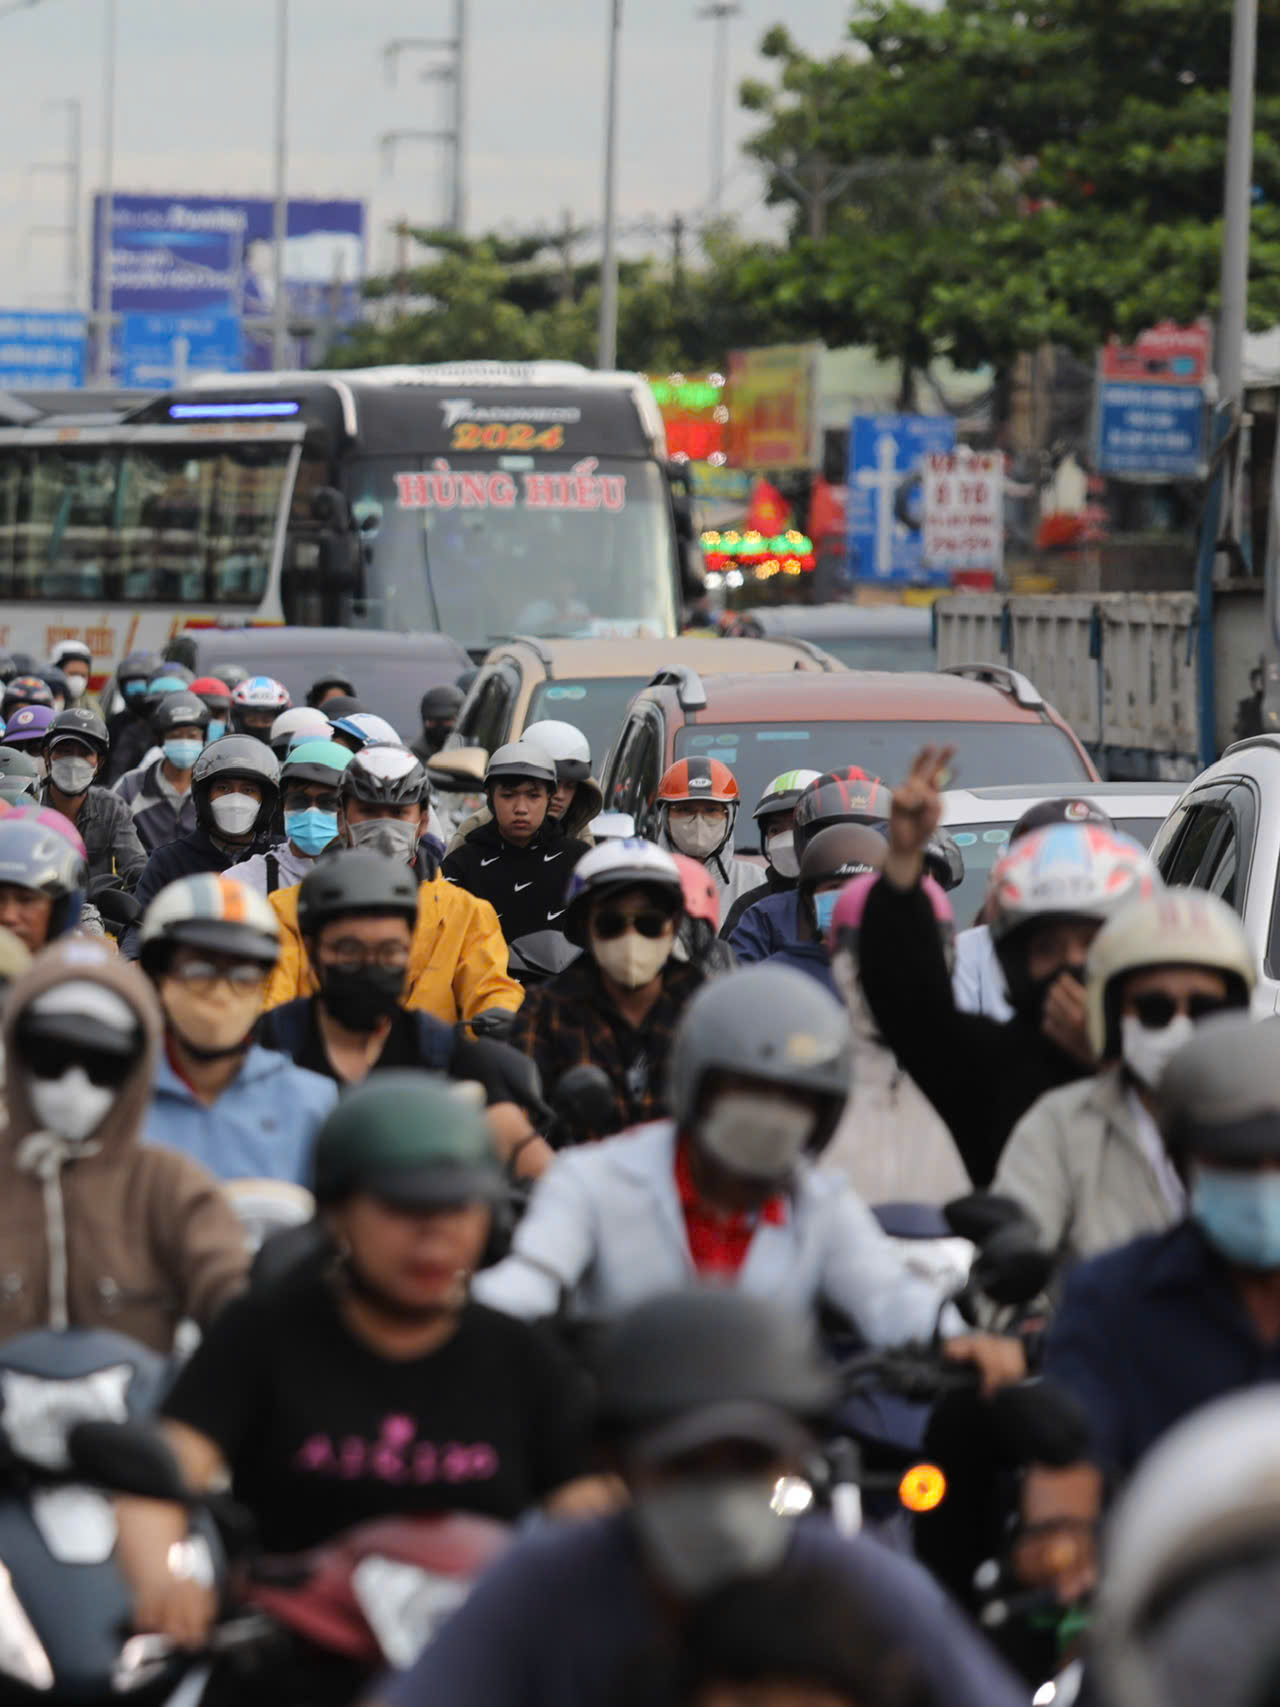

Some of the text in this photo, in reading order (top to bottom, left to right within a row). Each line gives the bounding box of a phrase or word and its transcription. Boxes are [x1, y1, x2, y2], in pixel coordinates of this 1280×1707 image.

[451, 423, 565, 450] 2024
[395, 456, 625, 511] HÙNG HIẾU
